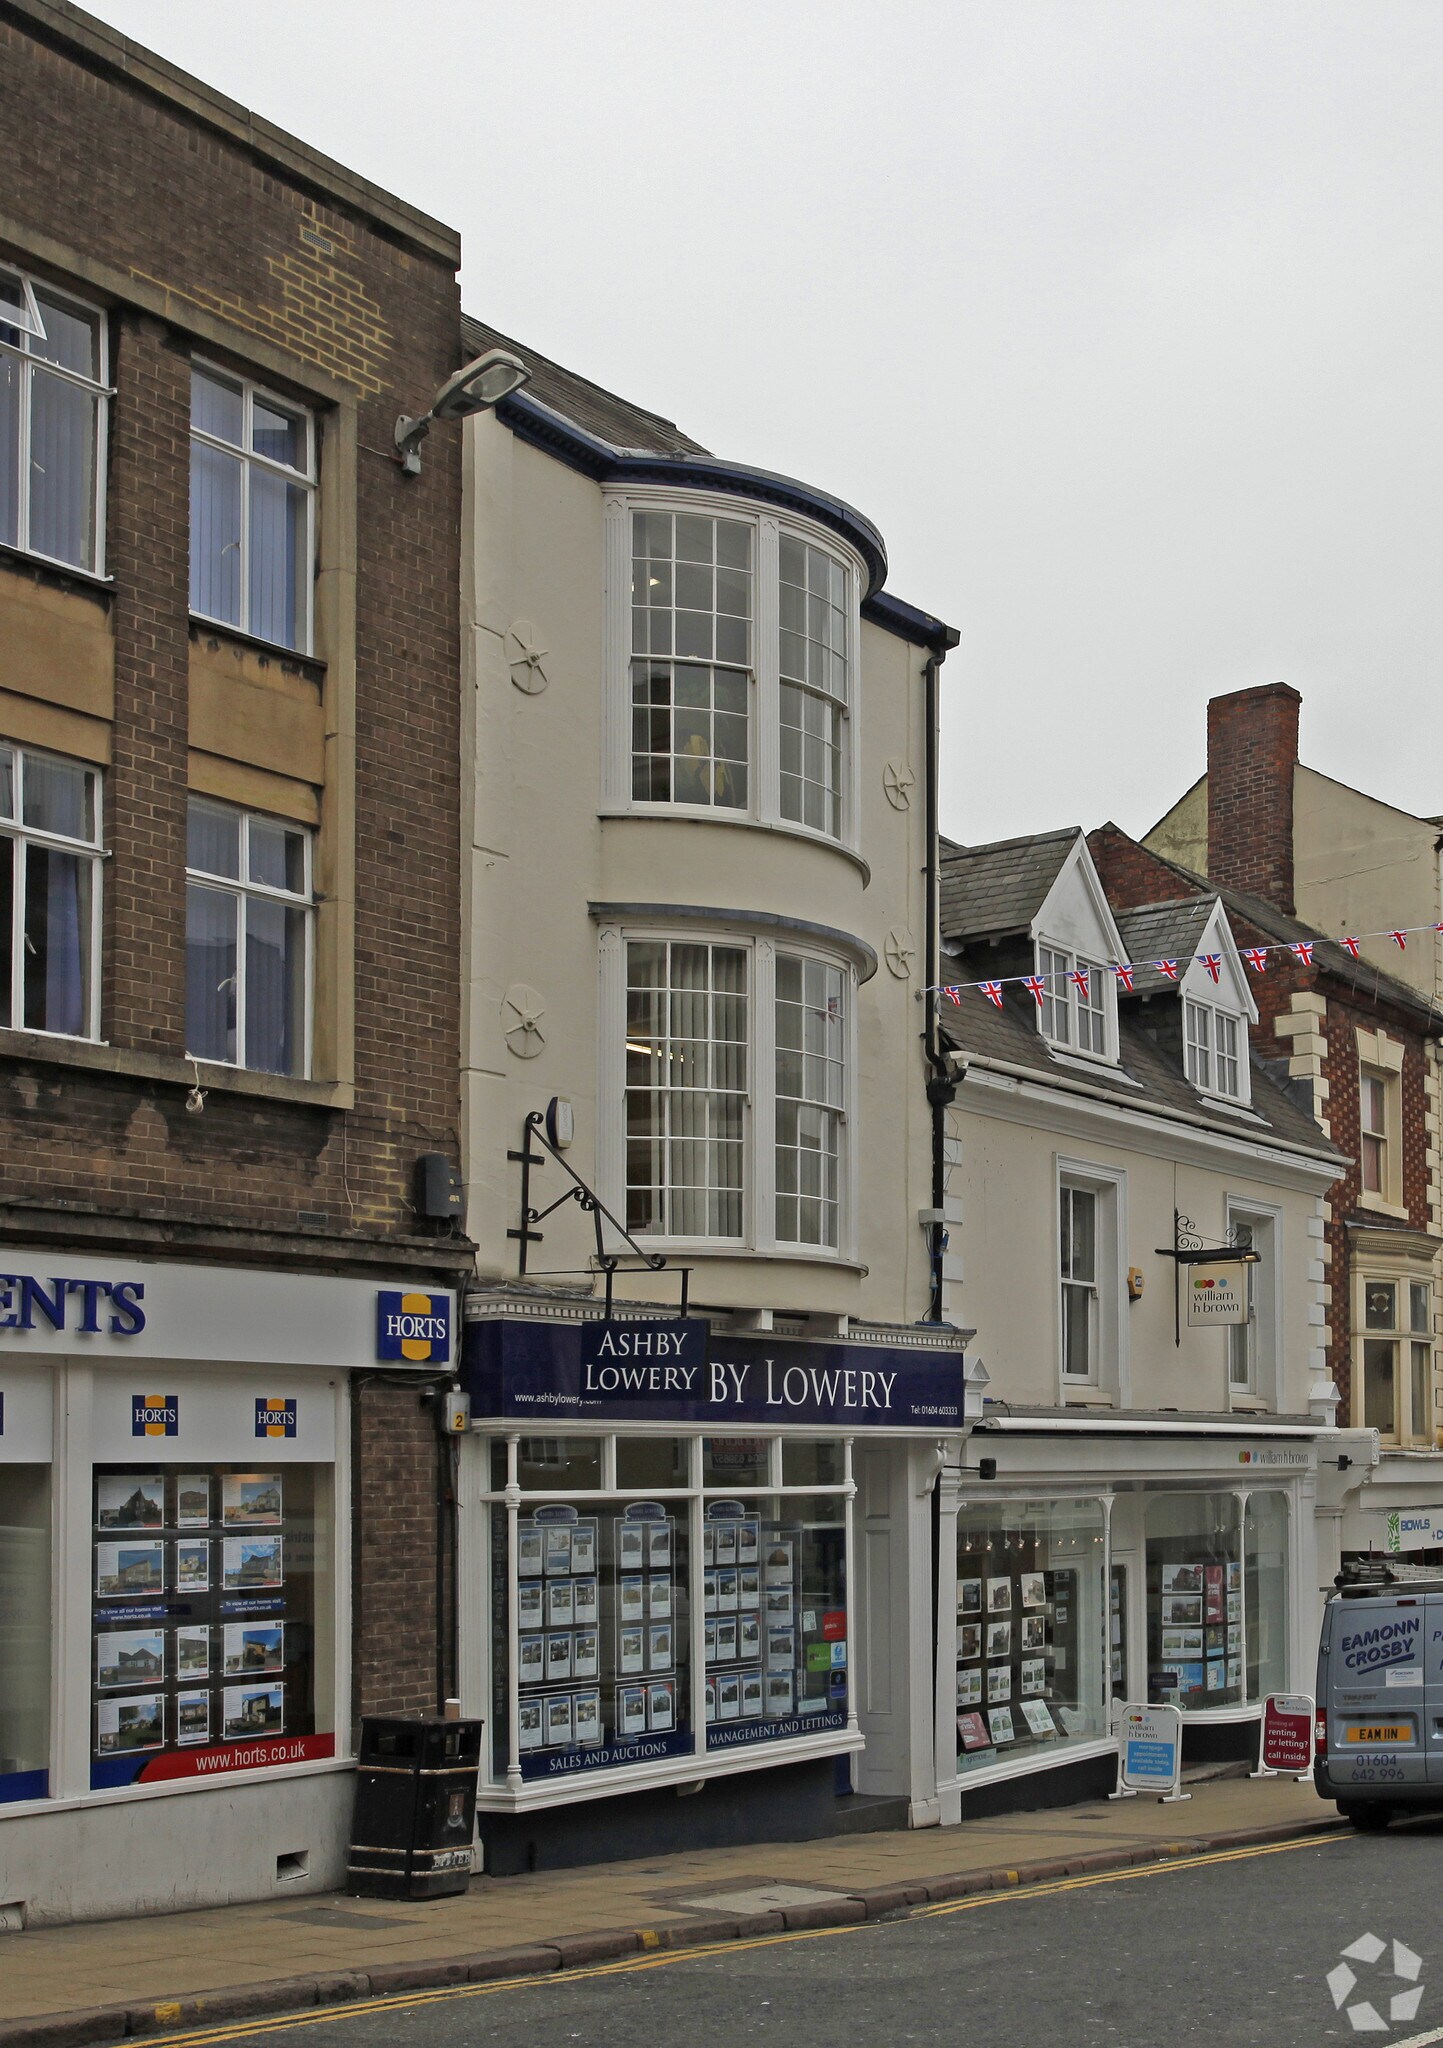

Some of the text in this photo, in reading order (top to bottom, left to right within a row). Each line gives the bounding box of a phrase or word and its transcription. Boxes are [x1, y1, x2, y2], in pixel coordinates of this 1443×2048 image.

[1193, 1290, 1234, 1301] william
[0, 1274, 146, 1335] ENTS
[1193, 1302, 1239, 1313] h brown
[386, 1315, 446, 1339] HORTS
[597, 1330, 688, 1356] ASHBY
[585, 1364, 698, 1390] LOWERY
[765, 1359, 898, 1409] LOWERY
[135, 1409, 176, 1422] HORTS
[911, 1405, 958, 1416] Tel: 01604 603333
[258, 1411, 294, 1425] HORTS
[455, 1414, 463, 1428] 2
[1400, 1519, 1430, 1532] BOWLS
[1342, 1618, 1420, 1652] EAMONN
[1345, 1637, 1414, 1668] CROSBY
[709, 1714, 843, 1745] MANAGEMENT AND LETTINGS
[1268, 1729, 1296, 1738] renting
[1359, 1728, 1381, 1740] EAM
[1279, 1739, 1308, 1749] letting?
[196, 1740, 306, 1771] www.horts.co.uk
[550, 1742, 667, 1771] SALES AND AUCTIONS
[1283, 1752, 1306, 1760] inside
[1356, 1754, 1397, 1766] 01604
[1351, 1769, 1405, 1781] 642 996
